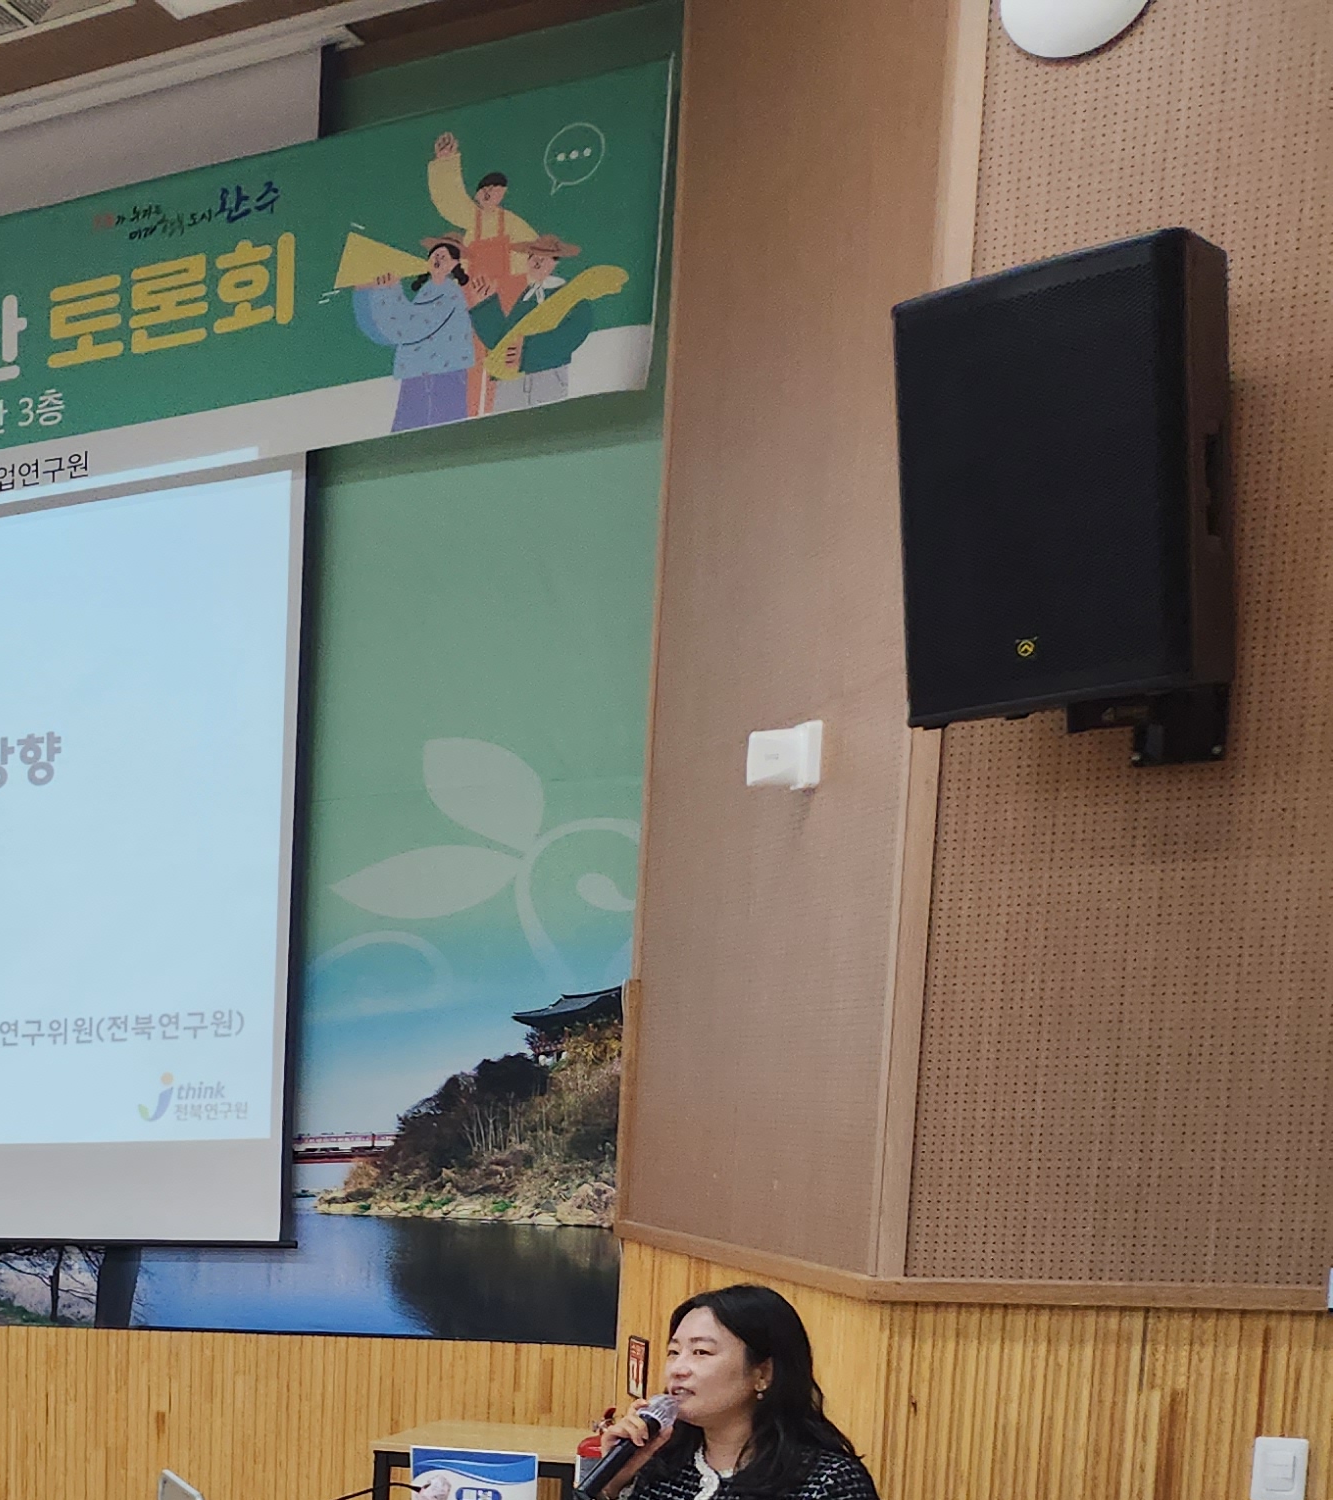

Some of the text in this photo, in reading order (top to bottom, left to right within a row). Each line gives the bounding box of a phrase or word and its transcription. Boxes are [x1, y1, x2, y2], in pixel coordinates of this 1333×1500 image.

[47, 231, 296, 368] 토론회
[17, 387, 67, 427] 3층
[174, 1101, 249, 1121] 전북연구원
